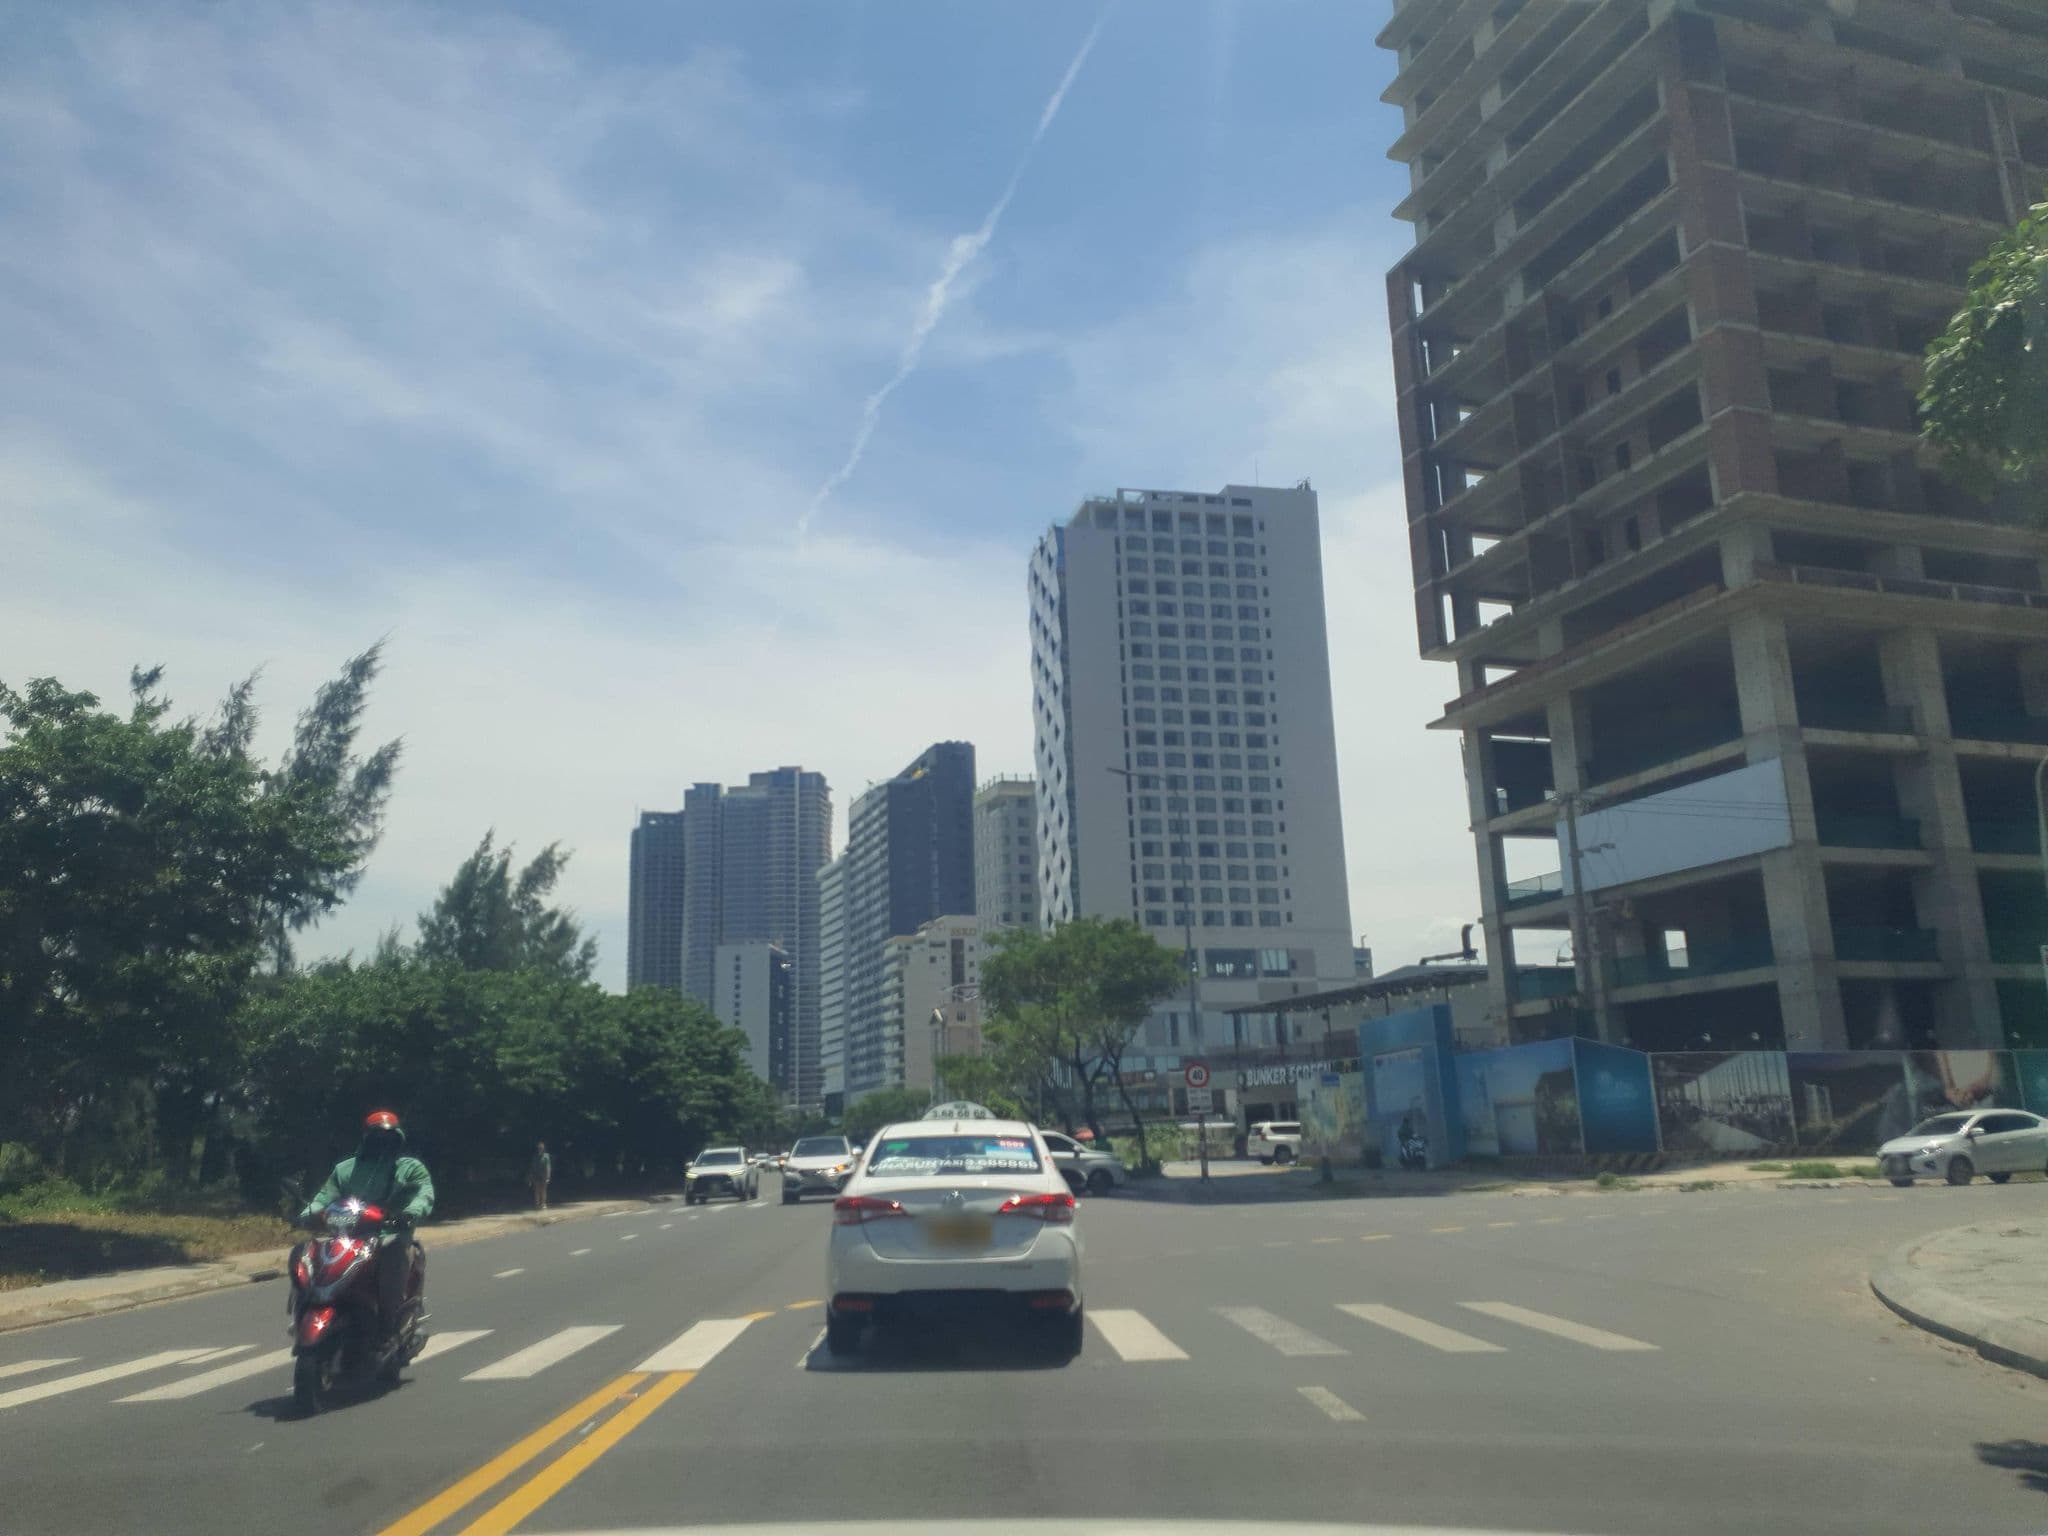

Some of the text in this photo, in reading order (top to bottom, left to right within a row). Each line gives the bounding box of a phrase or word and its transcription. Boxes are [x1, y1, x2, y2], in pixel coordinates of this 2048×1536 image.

[1193, 1069, 1203, 1081] 40
[1247, 1066, 1286, 1087] BUNKER
[940, 1159, 963, 1167] TAXI
